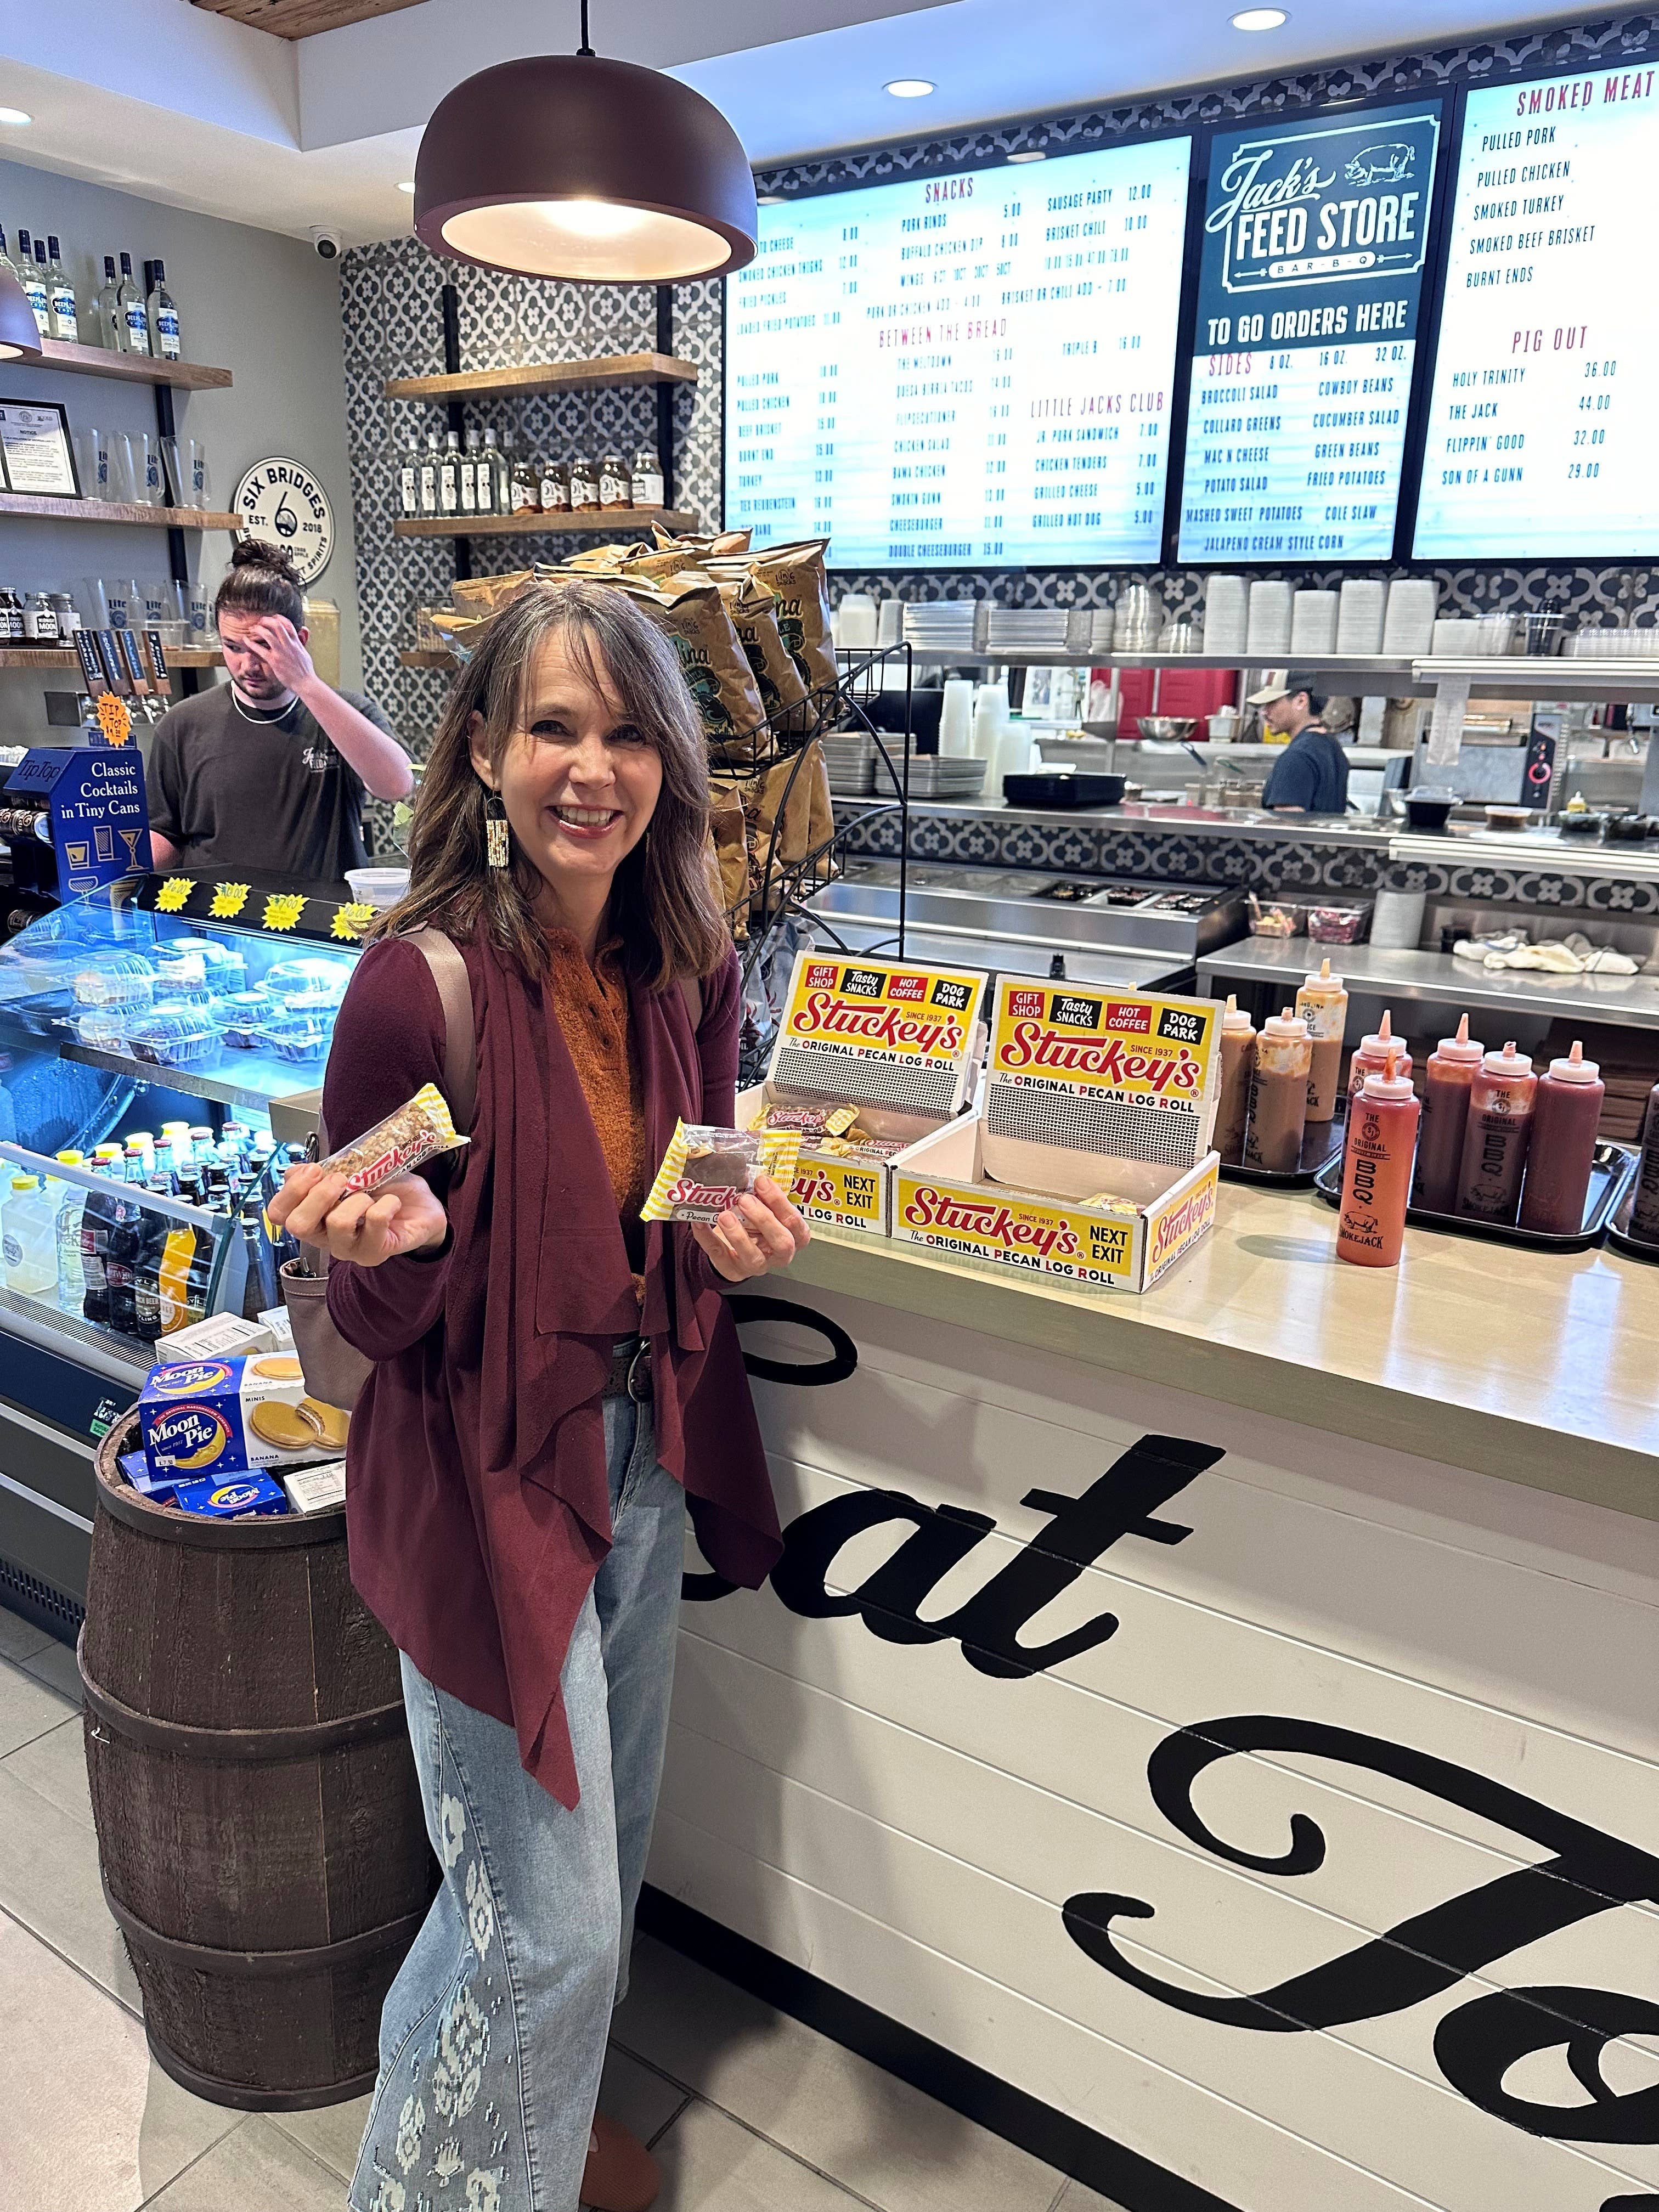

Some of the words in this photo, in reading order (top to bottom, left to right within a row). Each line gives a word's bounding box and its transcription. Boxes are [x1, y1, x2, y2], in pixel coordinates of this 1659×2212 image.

[1517, 81, 1593, 116] SMOKED
[1604, 71, 1655, 103] MEAT
[1482, 131, 1521, 151] PULLED
[1527, 126, 1556, 146] PORK
[1477, 168, 1516, 188] PULLED
[1522, 161, 1570, 182] CHICKEN
[926, 178, 973, 204] SNACKS
[1129, 184, 1151, 201] 12.00
[1205, 149, 1336, 233] Jack's
[1048, 193, 1083, 211] SAUSAGE
[1087, 189, 1113, 206] PARTY
[1474, 201, 1517, 221] SMOKED
[1523, 195, 1564, 215] TURKEY
[1046, 224, 1079, 241] BRISKET
[1083, 220, 1105, 236] CHILI
[1237, 207, 1308, 260] FEED
[1317, 191, 1419, 251] STORE
[1470, 235, 1513, 254] SMOKED
[1519, 232, 1543, 249] BEEF
[1549, 225, 1595, 246] BRISKET
[1466, 270, 1501, 287] BURNT
[1506, 267, 1533, 284] ENDS
[1208, 317, 1231, 346] TO
[1238, 314, 1263, 342] GO
[1271, 306, 1348, 340] ORDERS
[1355, 300, 1408, 332] HERE
[879, 326, 930, 347] BETWEEN
[940, 323, 959, 342] THE
[968, 319, 1006, 339] BREAD
[1512, 330, 1542, 353] PIG
[1554, 326, 1587, 350] OUT
[1209, 352, 1251, 376] SIDES
[1585, 361, 1616, 377] 36.00
[1453, 371, 1477, 387] HOLY
[1483, 368, 1525, 385] TRINITY
[1202, 387, 1245, 404] BROCCOLI
[1250, 385, 1278, 400] SALAD
[1319, 380, 1358, 396] COWBOY
[1363, 378, 1393, 393] BEANS
[1031, 398, 1071, 417] LITTLE
[1081, 394, 1121, 415] JACKS
[1130, 392, 1163, 412] CLUB
[1579, 395, 1610, 410] 44.00
[1313, 411, 1364, 427] CUCUMBER
[1369, 410, 1399, 425] SALAD
[1449, 405, 1467, 420] THE
[1471, 403, 1498, 418] JACK
[1204, 419, 1242, 433] COLLARD
[1246, 416, 1280, 431] GREENS
[1077, 427, 1119, 441] SANDWICH
[1497, 435, 1524, 449] GOOD
[1574, 429, 1605, 445] 32.00
[1204, 449, 1222, 463] MAC
[1237, 447, 1269, 462] CHEESE
[1315, 443, 1345, 458] GREEN
[1349, 442, 1379, 456] BEANS
[1036, 458, 1068, 471] CHICKEN
[1073, 456, 1107, 470] TENDERS
[1568, 463, 1599, 478] 29.00
[1307, 472, 1334, 486] FRIED
[1339, 471, 1385, 485] POTATOES
[1442, 471, 1461, 484] SON
[1467, 470, 1478, 483] OF
[1494, 467, 1523, 482] GUNN
[244, 476, 266, 510] SIX
[267, 467, 325, 519] BRIDGES
[1035, 486, 1065, 499] GRILLED
[1069, 483, 1097, 498] CHEESE
[1205, 478, 1235, 493] POTATO
[1240, 477, 1267, 490] SALAD
[249, 515, 268, 526] EST.
[1032, 514, 1063, 528] GRILLED
[1186, 509, 1221, 522] MASHED
[1224, 507, 1253, 521] SWEET
[1260, 506, 1302, 521] POTATOES
[1325, 506, 1347, 520] COLE
[1352, 506, 1377, 519] SLAW
[303, 523, 322, 533] 2018
[1252, 537, 1283, 550] CREAM
[1289, 536, 1313, 550] STYLE
[1319, 535, 1344, 549] CORN
[108, 600, 126, 610] Lite
[146, 600, 161, 610] Lite
[102, 703, 119, 716] TIP
[92, 761, 136, 777] Classic
[81, 780, 138, 797] Cocktails
[61, 805, 74, 819] in
[75, 803, 104, 818] Tiny
[109, 800, 140, 815] Cans
[813, 967, 834, 977] GIFT
[852, 971, 878, 985] Tasty
[809, 977, 834, 988] SHOP
[845, 982, 877, 996] SNACKS
[899, 979, 918, 988] HOT
[941, 984, 964, 996] DOG
[889, 988, 924, 999] COFFEE
[936, 995, 966, 1008] PARK
[1016, 993, 1038, 1005] GIFT
[1012, 1004, 1041, 1017] SHOP
[1062, 998, 1092, 1016] Tasty
[1119, 1007, 1140, 1017] HOT
[794, 992, 962, 1052] Stuckey's
[906, 1012, 924, 1020] SINCE
[1056, 1012, 1092, 1026] SNACKS
[1108, 1017, 1148, 1030] COFFEE
[1170, 1013, 1197, 1028] DOG
[1164, 1025, 1198, 1041] PARK
[803, 1041, 854, 1057] ORIGINAL
[857, 1048, 896, 1063] PECAN
[899, 1055, 922, 1065] LOG
[926, 1058, 954, 1071] ROLL
[1001, 1022, 1199, 1091] Stuckey's
[1130, 1045, 1153, 1054] SINCE
[1155, 1048, 1173, 1057] 1937
[999, 1073, 1012, 1084] The
[1014, 1076, 1075, 1093] ORIGINAL
[1079, 1086, 1124, 1102] PECAN
[1128, 1093, 1155, 1107] LOG
[1160, 1098, 1194, 1113] ROLL
[1496, 1090, 1510, 1098] THE
[1365, 1113, 1379, 1122] THE
[1354, 1138, 1386, 1152] ORIGINAL
[844, 1175, 875, 1192] NEXT
[1352, 1159, 1376, 1205] BBQ
[847, 1192, 872, 1209] EXIT
[809, 1209, 832, 1220] LOG
[836, 1214, 866, 1228] ROLL
[905, 1188, 1078, 1255] Stuckey's
[1018, 1213, 1037, 1223] SINCE
[1039, 1217, 1053, 1226] 1937
[1153, 1181, 1212, 1263] Stuckey's
[1090, 1225, 1128, 1246] NEXT
[1339, 1226, 1384, 1249] SMOKEJACK
[909, 1230, 923, 1242] The
[926, 1234, 989, 1257] ORIGINAL
[994, 1249, 1041, 1268] PECAN
[1046, 1261, 1073, 1275] LOG
[1078, 1268, 1114, 1284] ROLL
[1092, 1245, 1124, 1264] EXIT
[150, 1367, 204, 1386] Moon
[184, 1370, 214, 1384] Pie
[148, 1414, 200, 1446] Moon
[184, 1426, 213, 1448] Pie
